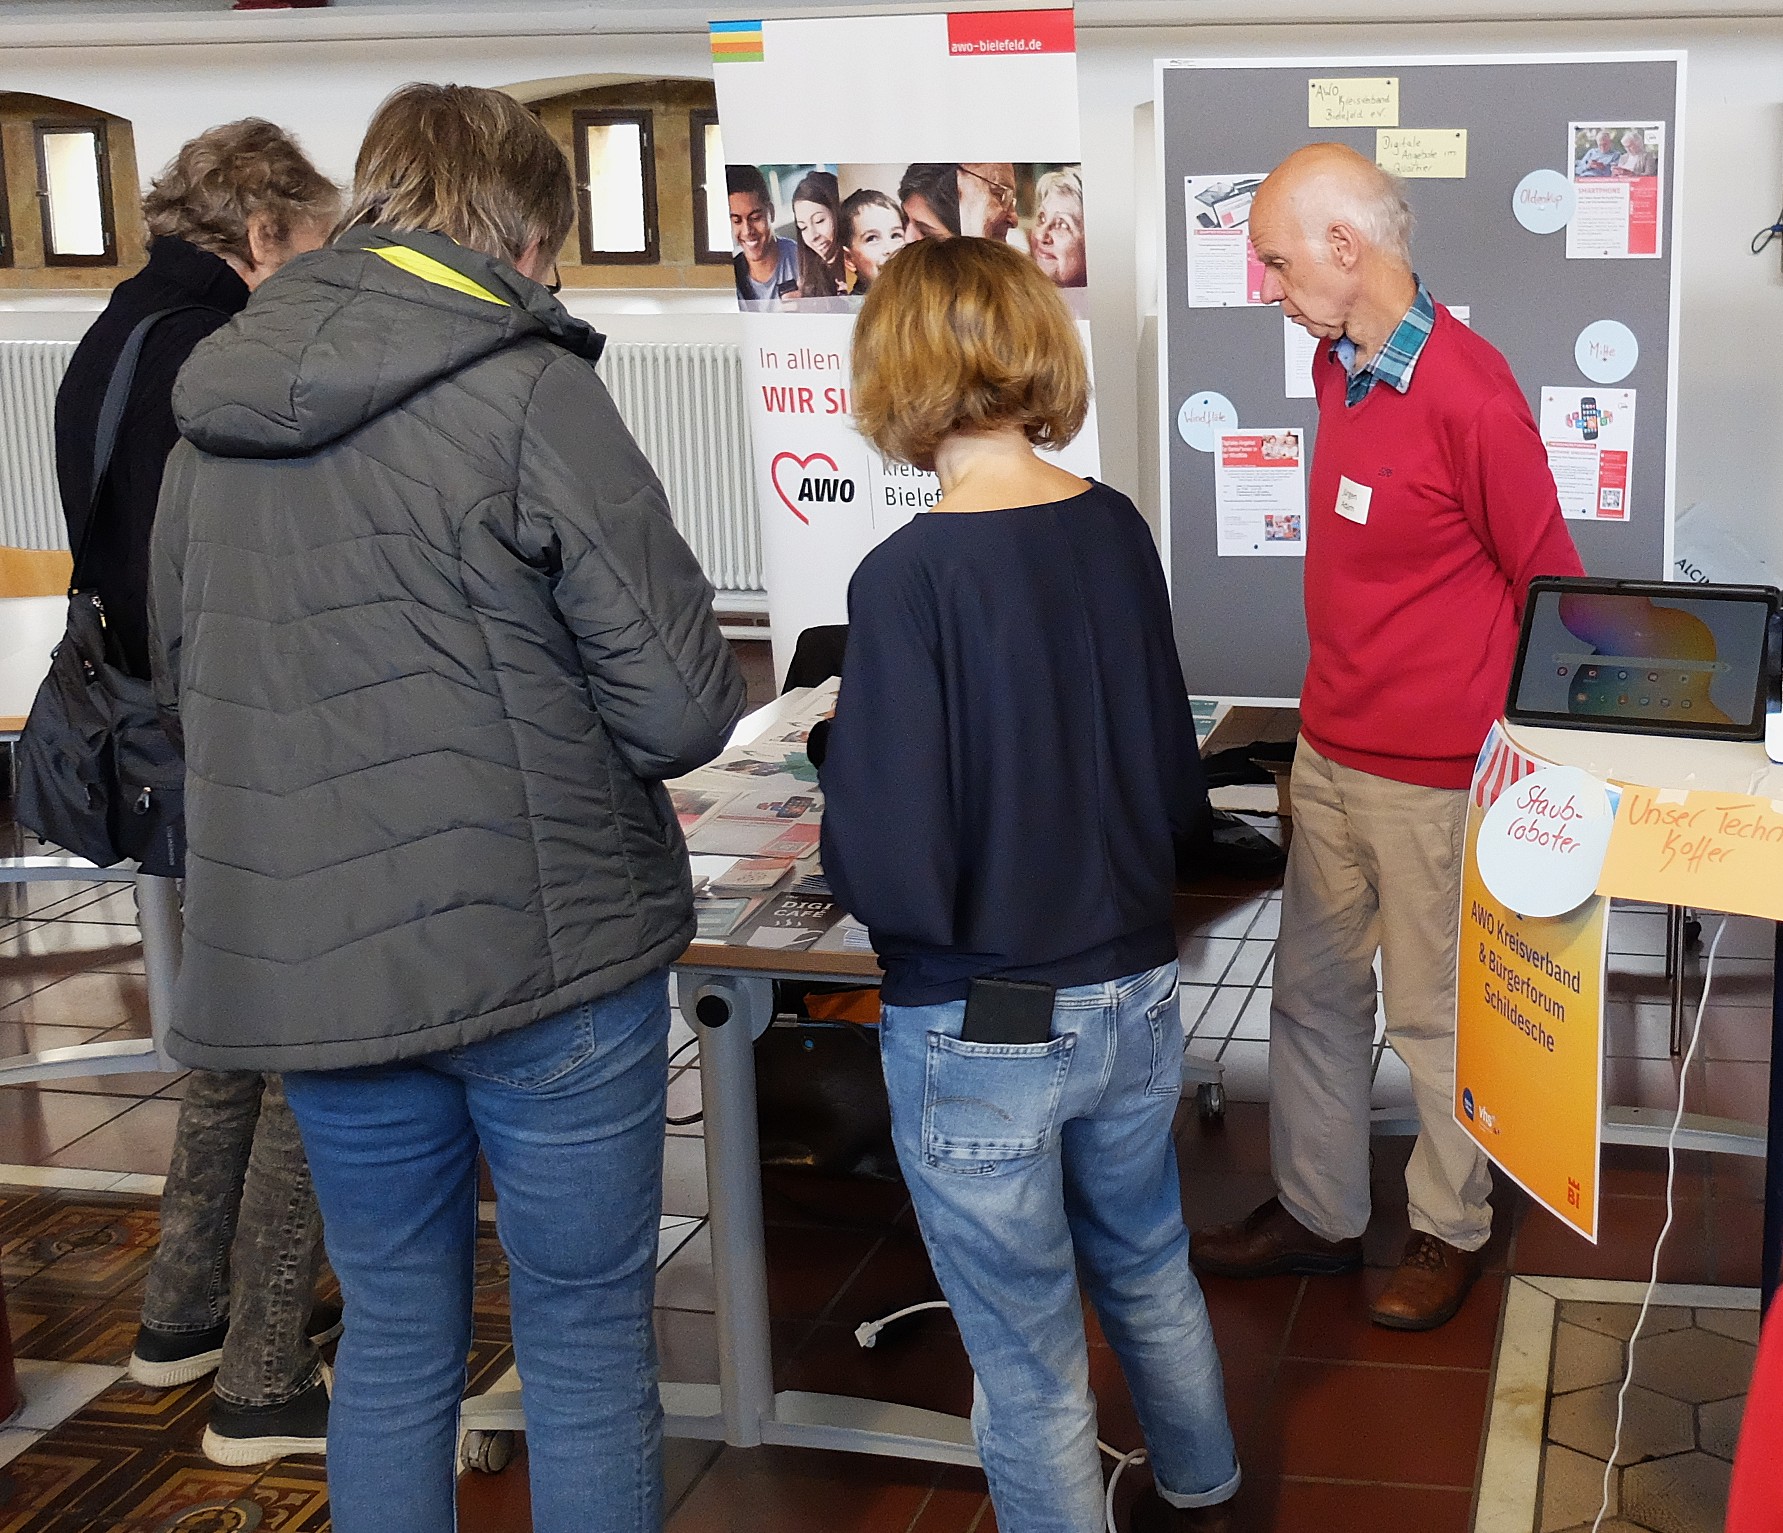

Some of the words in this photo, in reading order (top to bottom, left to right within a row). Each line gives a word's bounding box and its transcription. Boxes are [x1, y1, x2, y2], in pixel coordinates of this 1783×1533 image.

[950, 38, 1043, 53] awo-bielefeld.de
[1314, 84, 1340, 101] AWO
[759, 347, 778, 369] In
[787, 348, 840, 370] allen
[762, 385, 815, 414] WIR
[798, 477, 855, 503] AWO
[1516, 785, 1584, 819] Staub-
[1628, 794, 1707, 829] Unser
[1507, 817, 1581, 854] roboter
[1659, 828, 1738, 874] Koffer
[773, 909, 827, 918] CAFÉ
[781, 900, 835, 910] DIGI
[1470, 900, 1495, 935] AWO
[1496, 919, 1581, 994] Kreisverband
[1478, 942, 1487, 965] &
[1489, 950, 1566, 1022] Bürgerforum
[1484, 982, 1555, 1052] Schildesche
[1478, 1104, 1493, 1128] vhs
